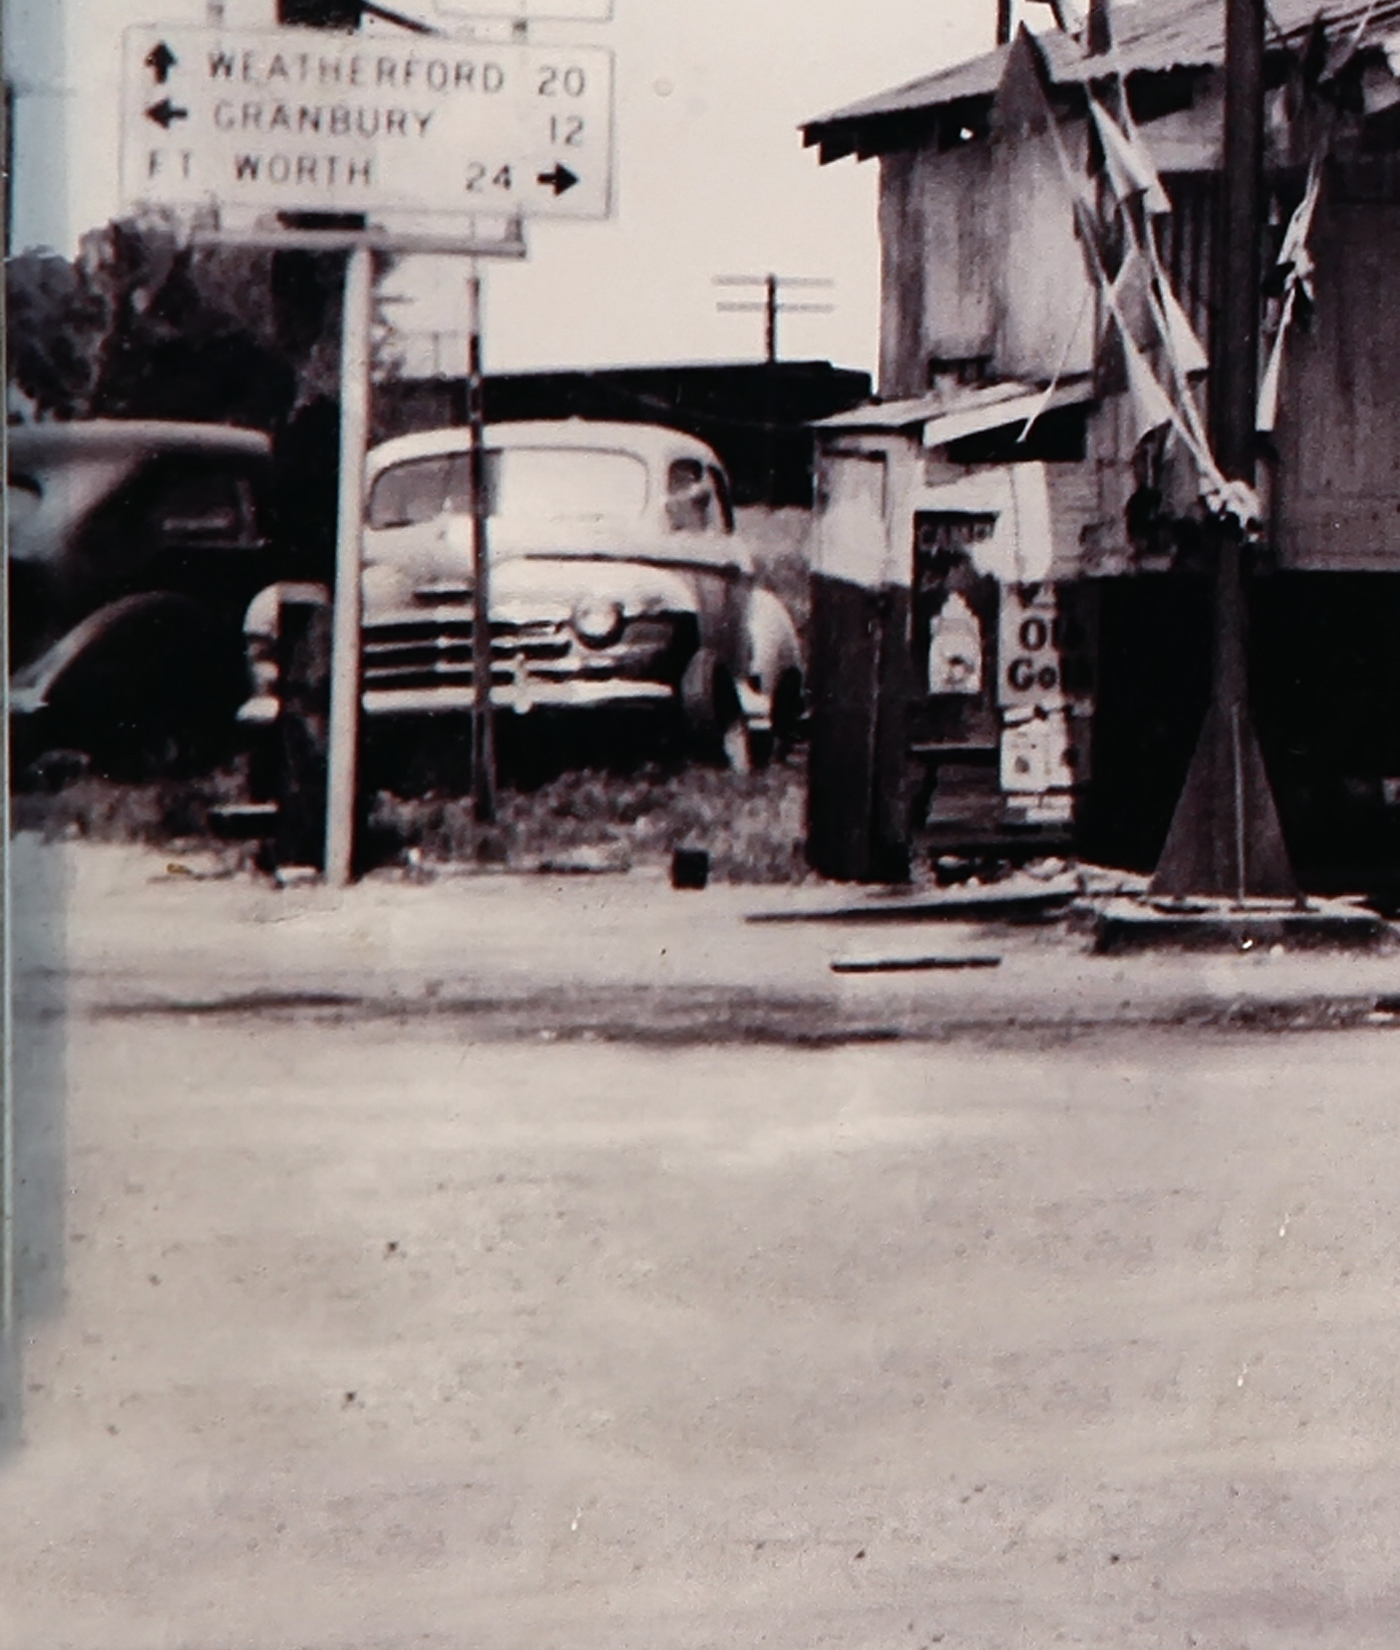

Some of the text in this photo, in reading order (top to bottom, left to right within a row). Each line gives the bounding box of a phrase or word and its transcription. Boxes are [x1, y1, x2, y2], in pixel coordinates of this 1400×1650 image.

[207, 51, 587, 99] WEATHERFORD 20
[213, 100, 586, 147] GRANBURY 12
[148, 150, 514, 193] FT WORTH 24
